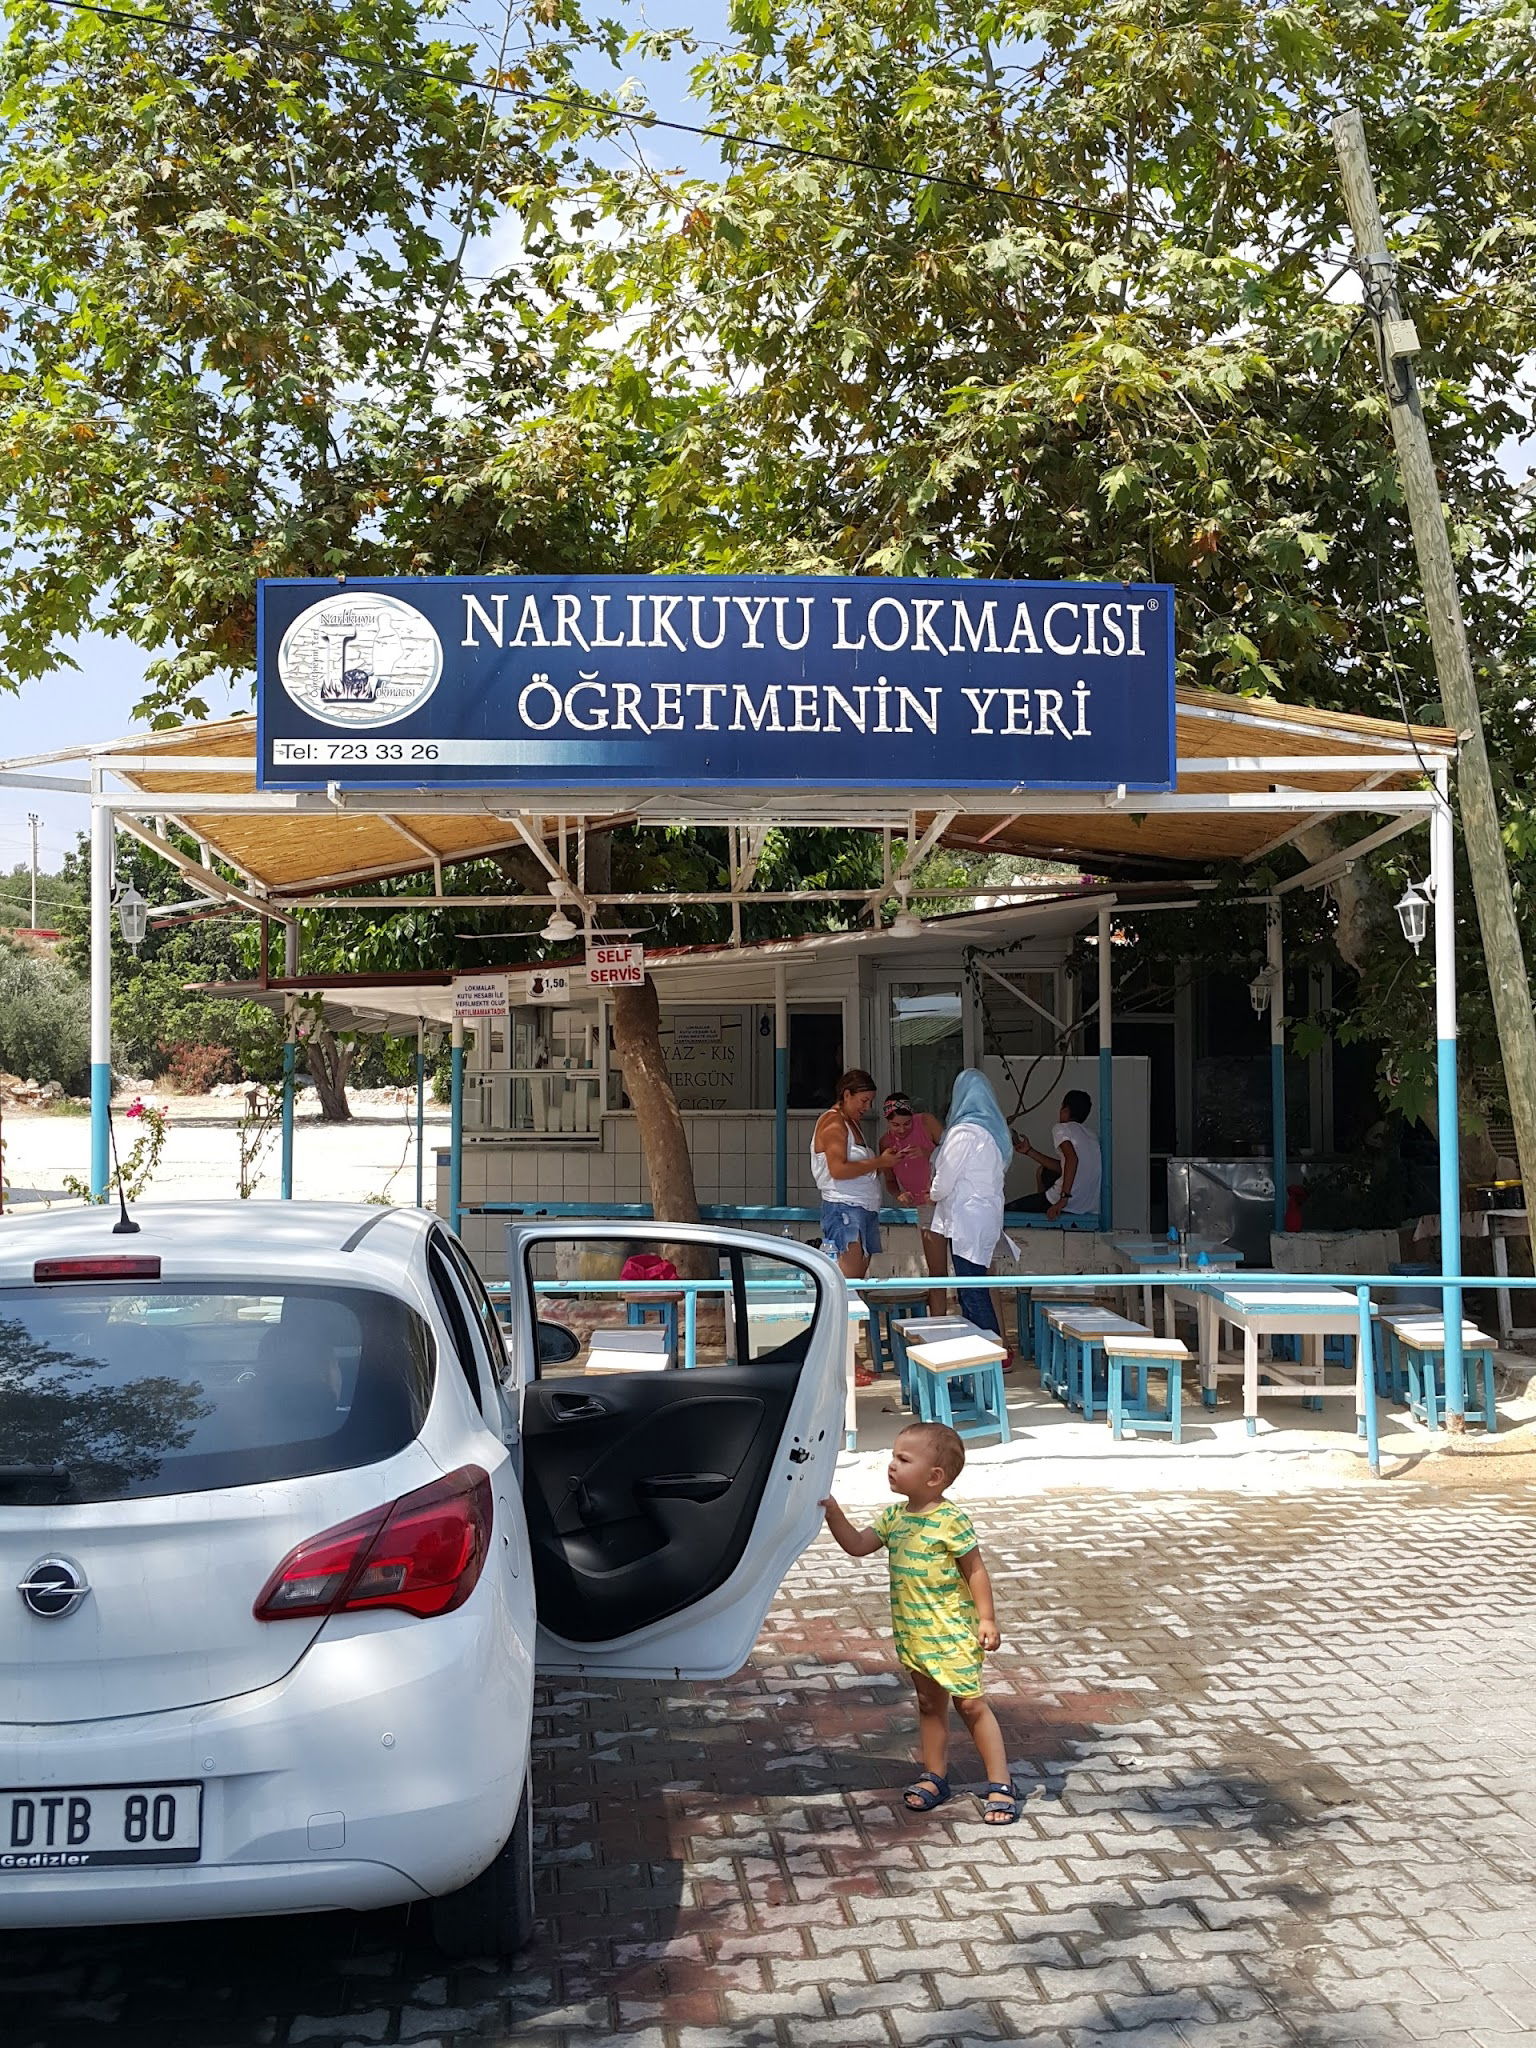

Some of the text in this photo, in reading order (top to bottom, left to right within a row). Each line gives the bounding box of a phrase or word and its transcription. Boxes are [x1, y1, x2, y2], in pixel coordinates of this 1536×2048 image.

[460, 594, 815, 652] NARLIKUYU
[518, 671, 1092, 741] ÖĞRETMENİN YERİ
[281, 744, 439, 759] Tel: 723 33 26
[597, 949, 632, 964] SELF
[590, 965, 641, 983] SERVİS
[661, 1046, 695, 1061] YAZ
[712, 1045, 735, 1063] KIŞ
[11, 1794, 176, 1847] DTB 80
[0, 1853, 89, 1868] Gedizler
